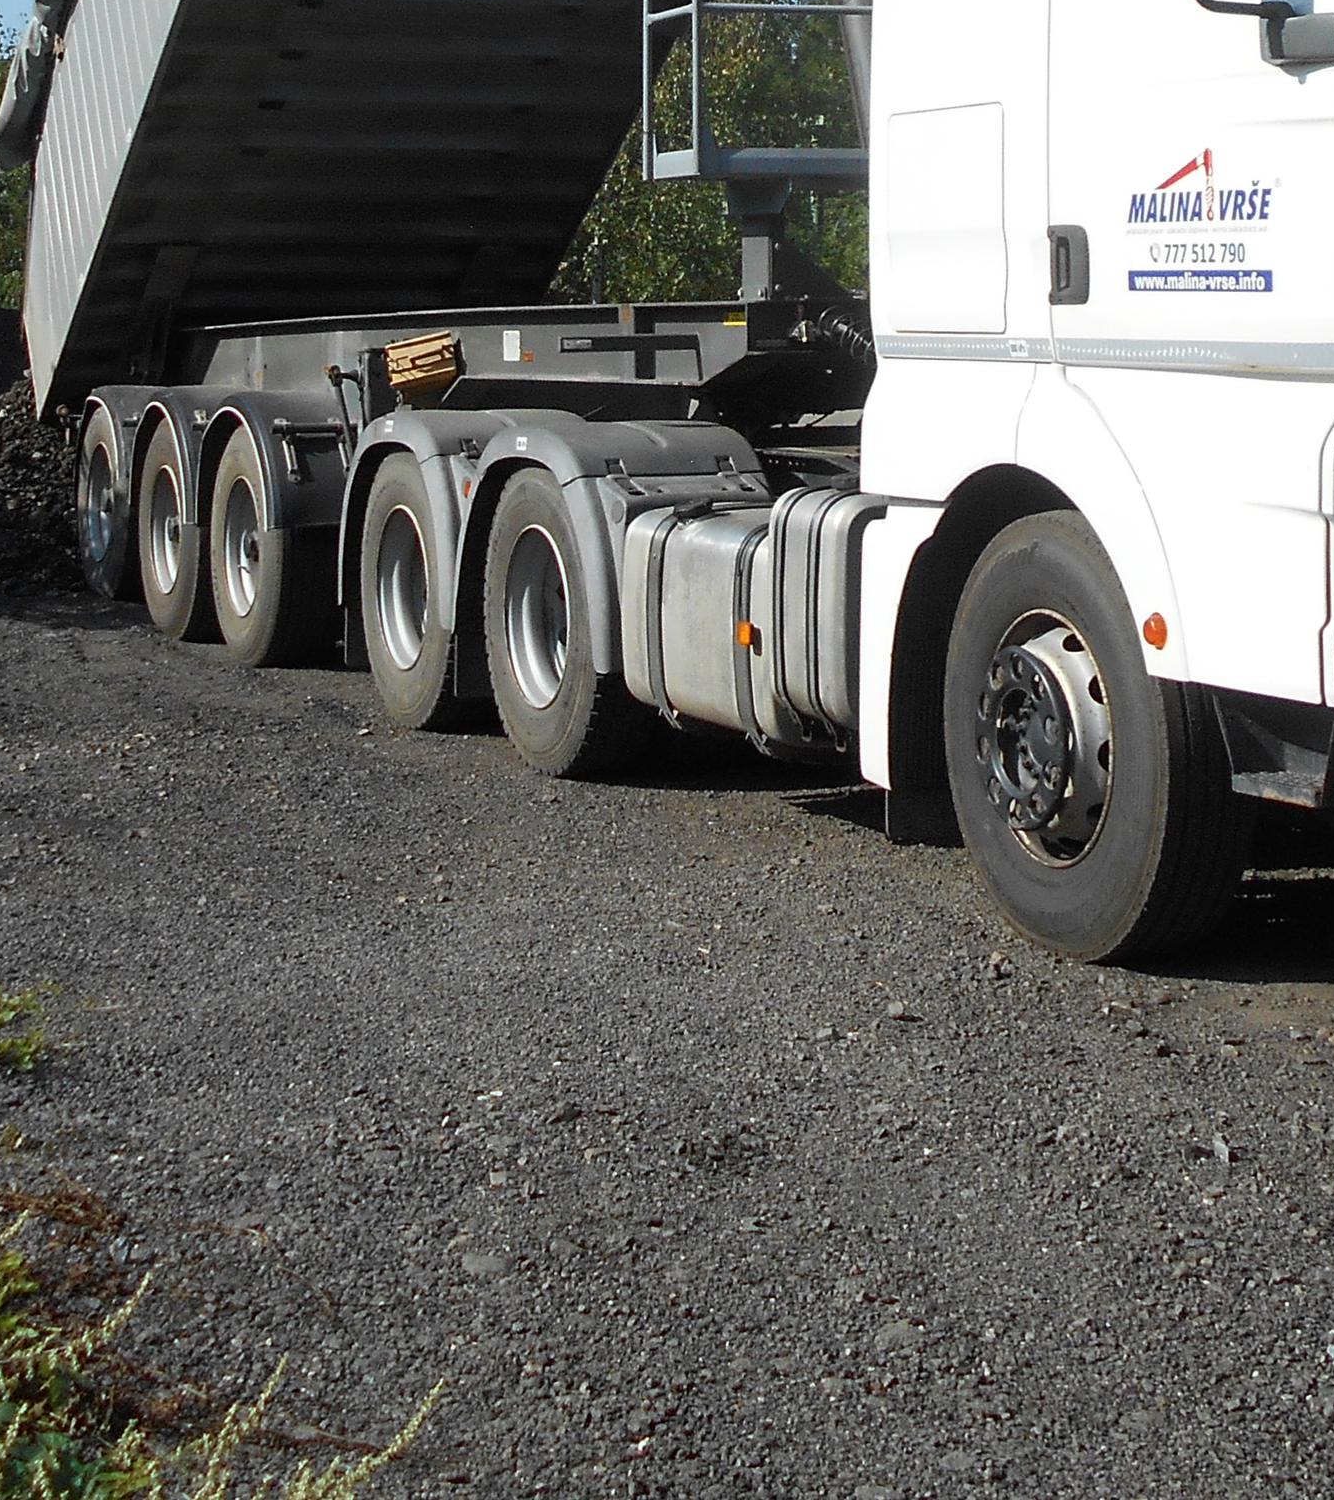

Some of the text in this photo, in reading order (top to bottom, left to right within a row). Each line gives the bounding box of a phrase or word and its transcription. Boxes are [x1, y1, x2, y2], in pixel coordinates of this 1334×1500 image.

[1127, 180, 1273, 223] MALINA VRŠE
[1164, 242, 1246, 263] 777 512 790
[1133, 272, 1266, 290] www.malina-vrse.info
